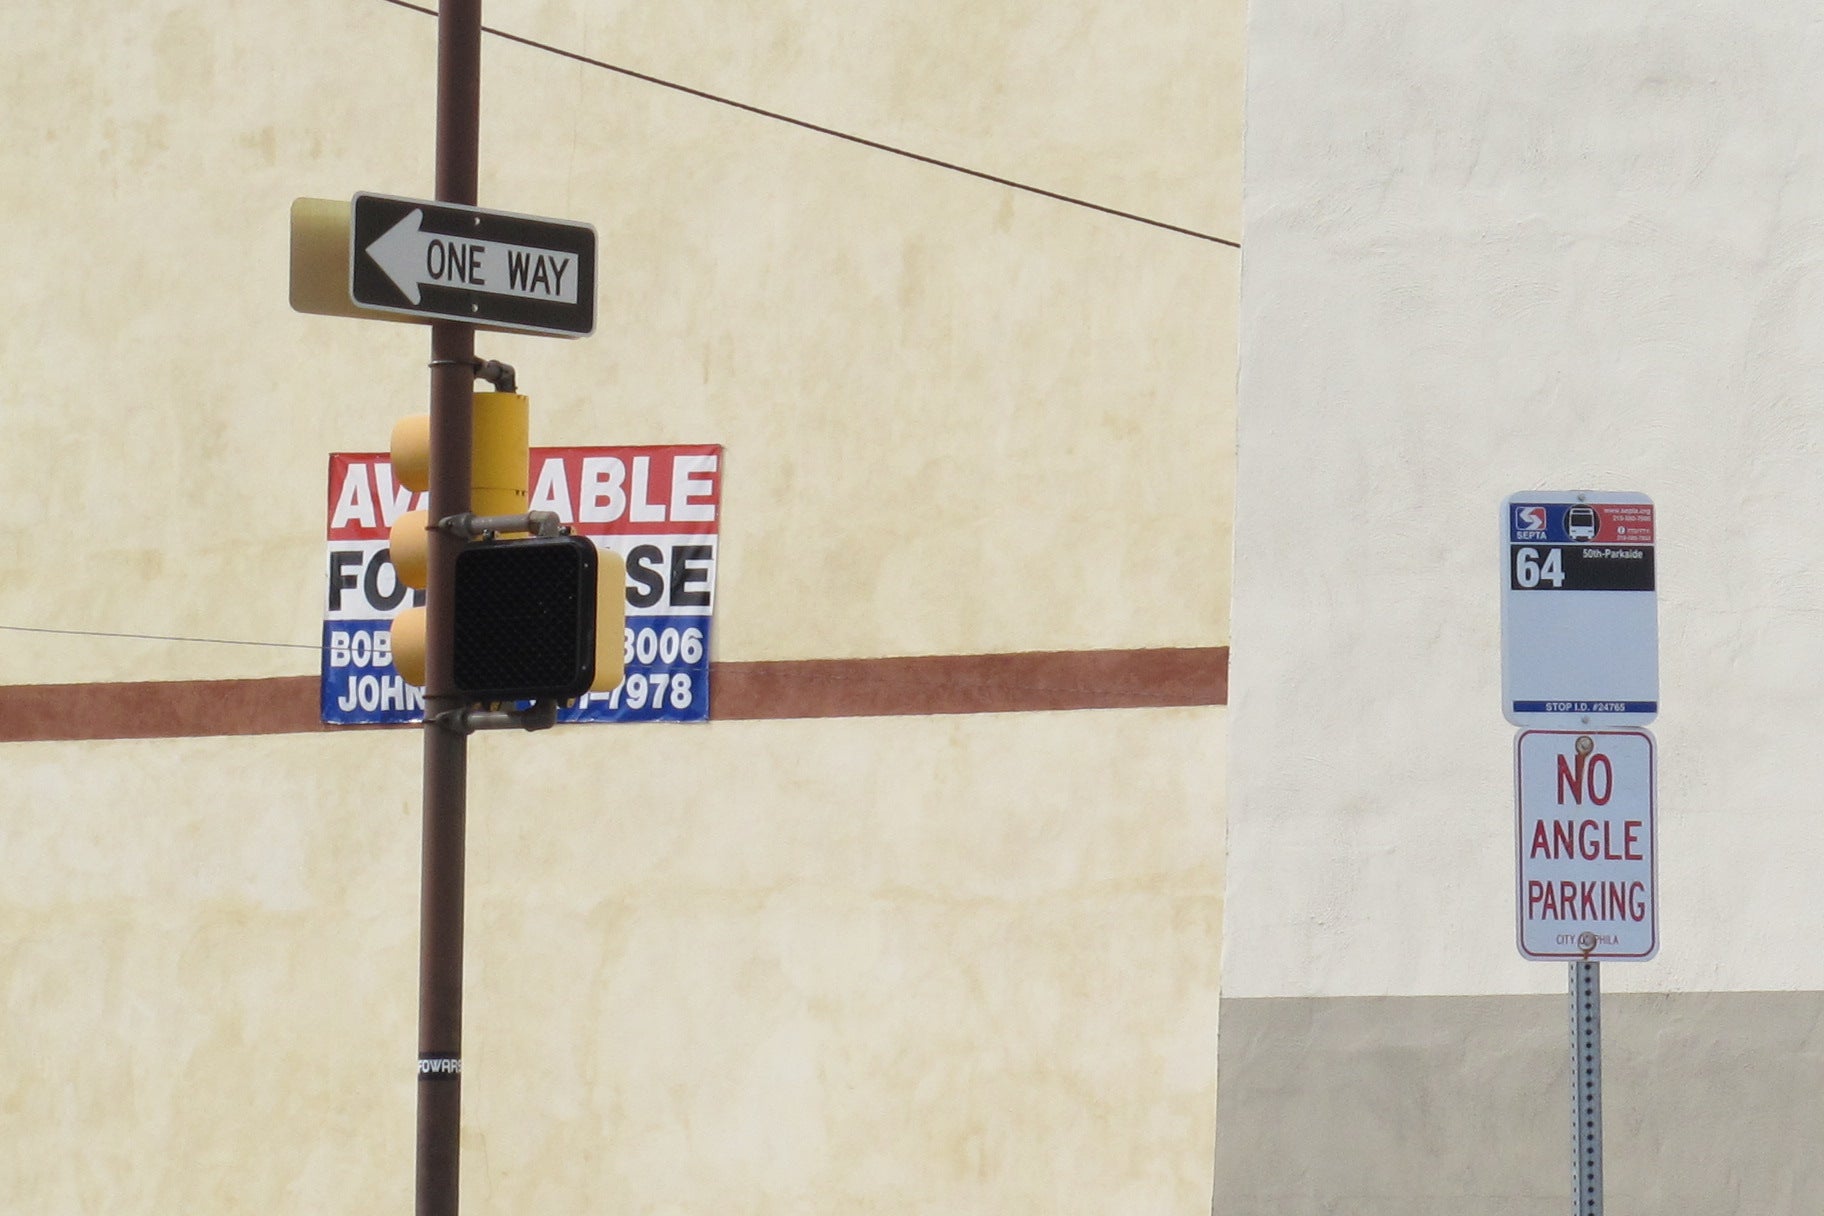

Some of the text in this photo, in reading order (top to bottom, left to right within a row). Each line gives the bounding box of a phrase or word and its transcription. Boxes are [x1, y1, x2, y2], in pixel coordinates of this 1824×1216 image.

[426, 237, 570, 297] ONE WAY
[330, 454, 718, 529] AVABLE
[1516, 531, 1548, 540] SEPTA
[328, 548, 426, 612] FO
[1516, 547, 1566, 588] 64
[1545, 703, 1626, 712] STOP I.D. #24765
[1556, 753, 1613, 806] NO
[1529, 819, 1644, 861] ANGLE
[1528, 880, 1646, 922] PARKING
[1556, 934, 1576, 945] CITY
